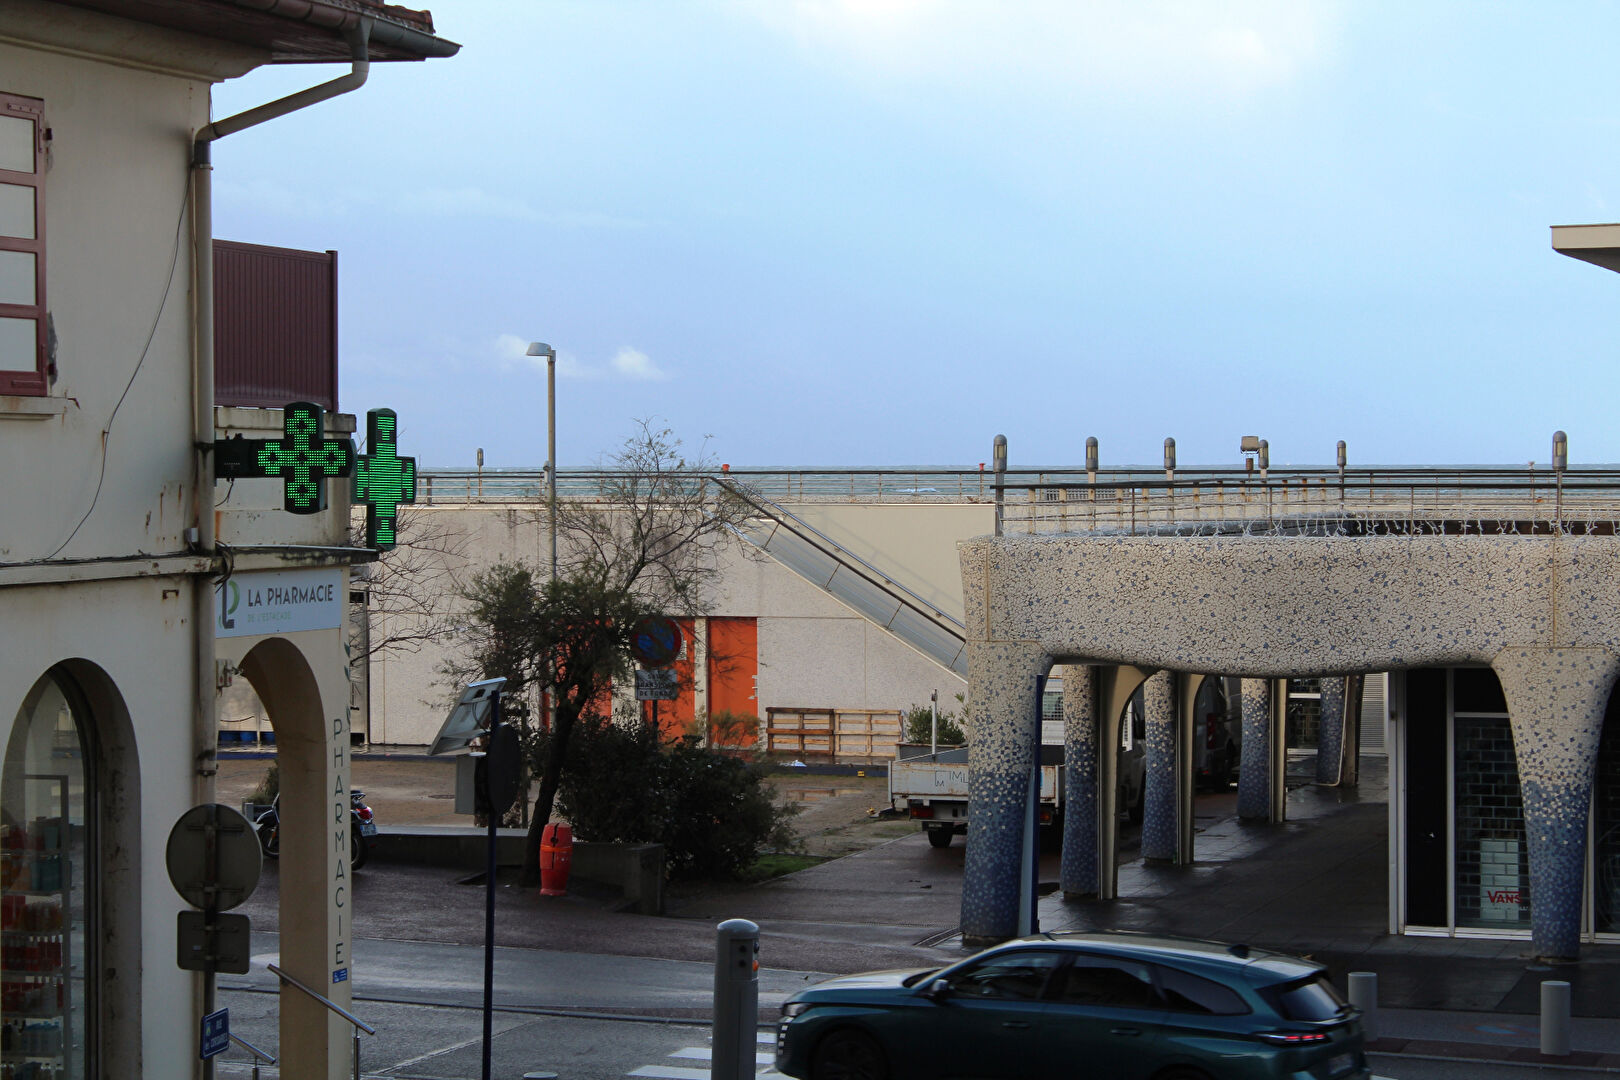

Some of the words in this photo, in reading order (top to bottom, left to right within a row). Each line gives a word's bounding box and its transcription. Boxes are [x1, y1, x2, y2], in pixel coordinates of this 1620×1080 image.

[247, 588, 263, 607] LA
[267, 584, 334, 606] PHARMACIE
[332, 718, 345, 965] PHARMACIE
[1487, 890, 1523, 904] VANS
